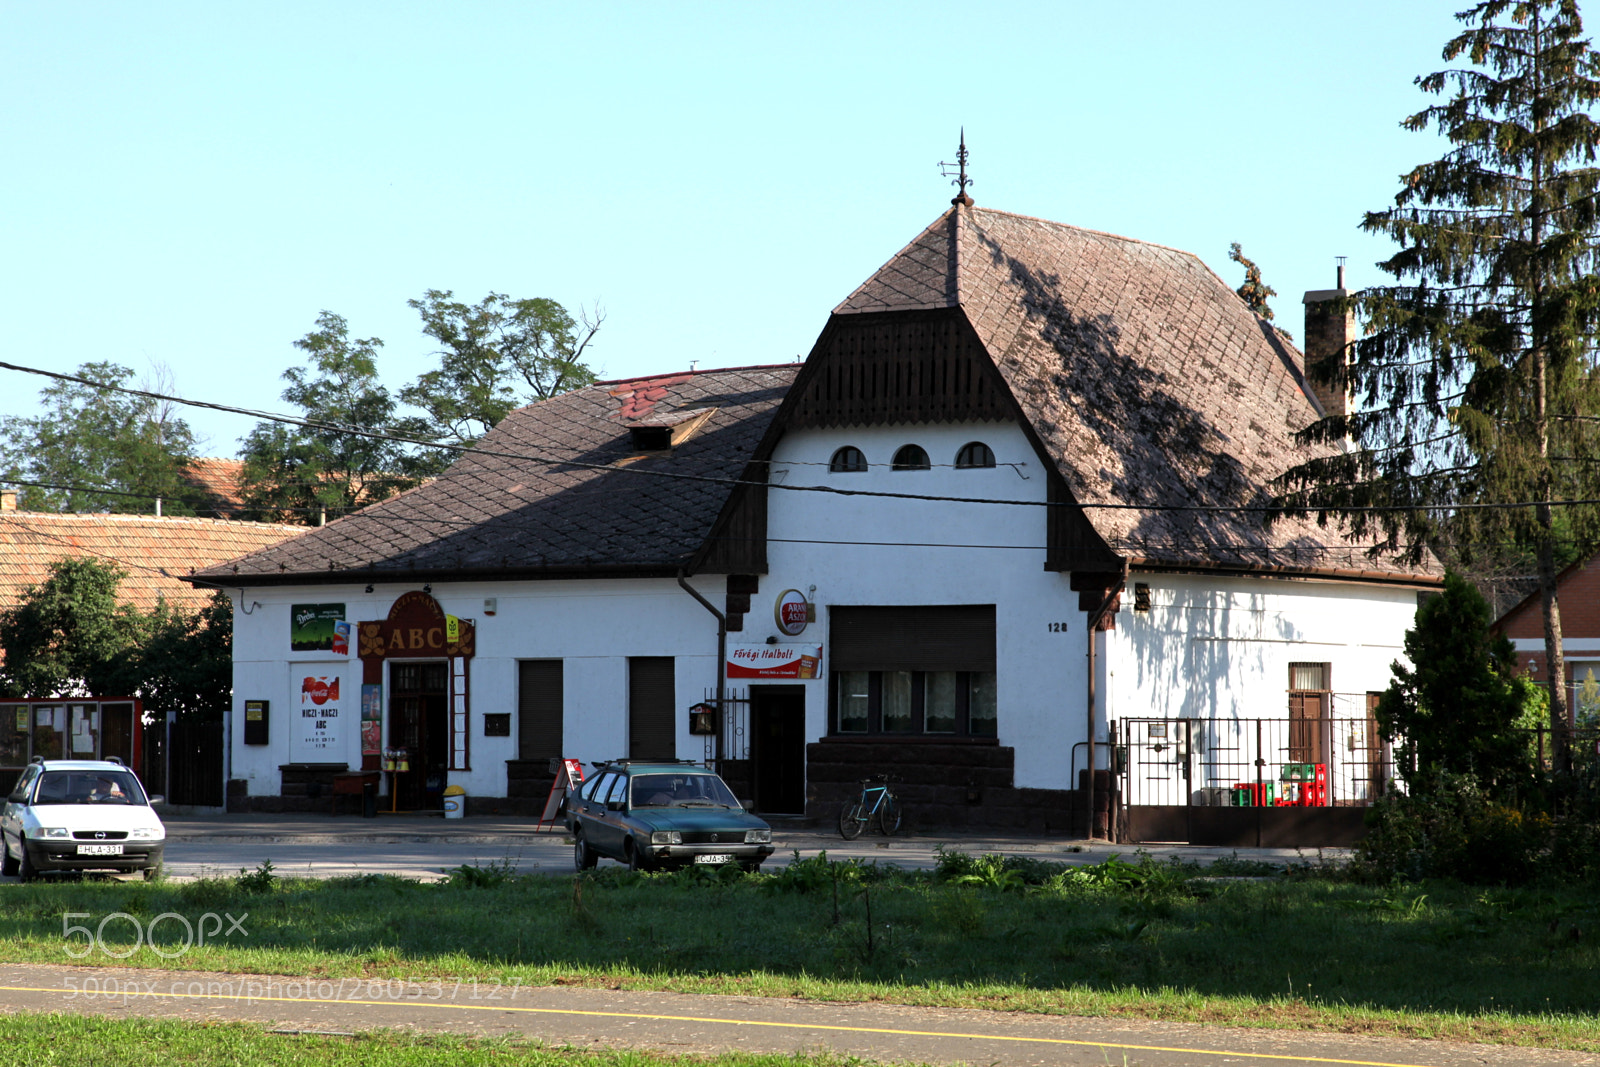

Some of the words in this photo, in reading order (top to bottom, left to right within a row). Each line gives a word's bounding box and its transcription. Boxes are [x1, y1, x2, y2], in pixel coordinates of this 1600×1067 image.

[788, 603, 807, 613] ARAN
[787, 612, 807, 621] ÁSZO
[388, 627, 443, 649] ABC
[761, 648, 793, 659] Italbolt
[315, 720, 327, 729] ABC
[84, 845, 121, 854] HLA-331
[700, 855, 733, 863] CJA-3
